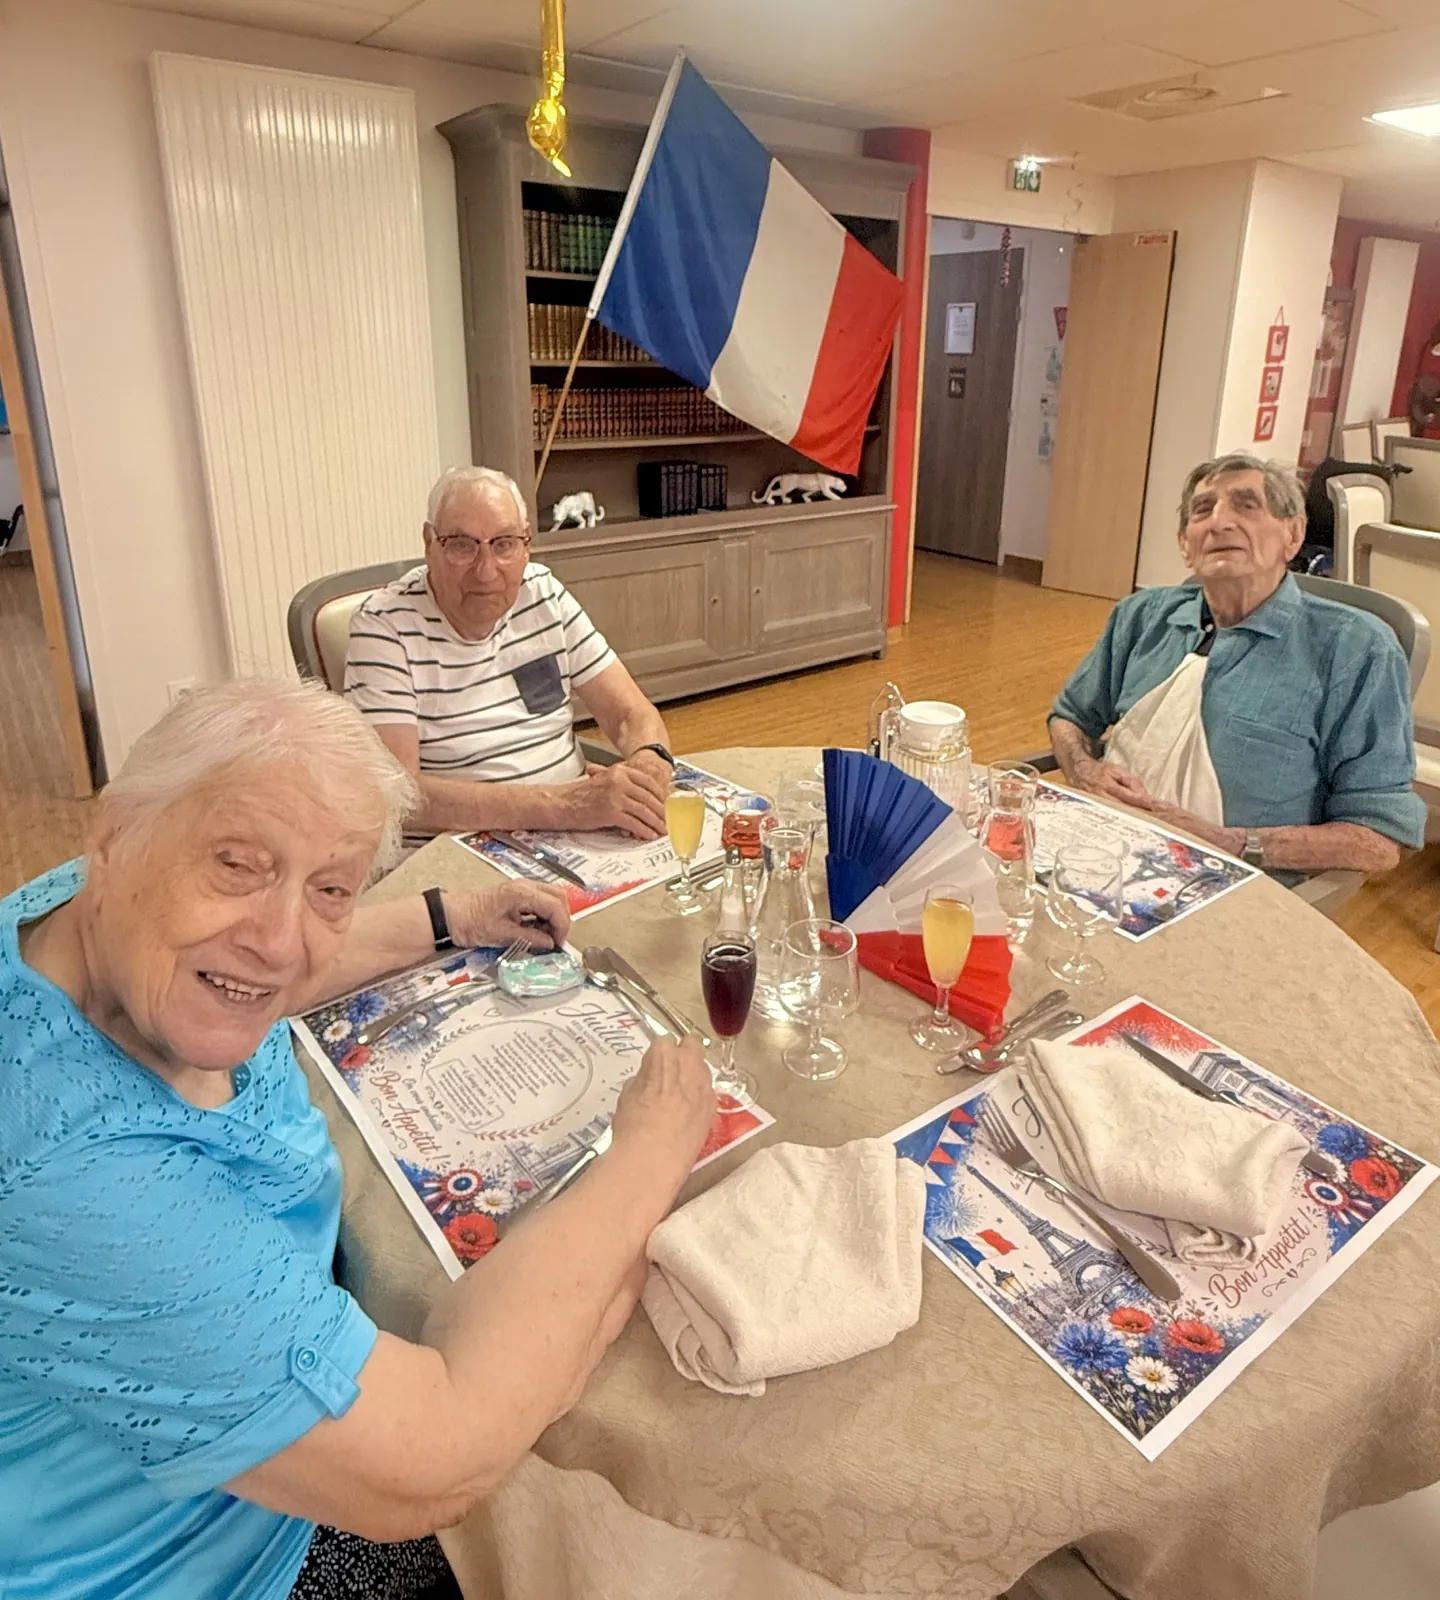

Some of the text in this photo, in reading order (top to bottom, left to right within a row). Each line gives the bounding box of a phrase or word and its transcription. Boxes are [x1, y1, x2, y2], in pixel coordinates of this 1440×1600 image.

[555, 1002, 644, 1058] Juillet
[369, 1070, 402, 1102] Bon
[387, 1102, 443, 1156] Appétit
[1207, 1270, 1258, 1309] Bon
[1254, 1216, 1310, 1279] Appétit
